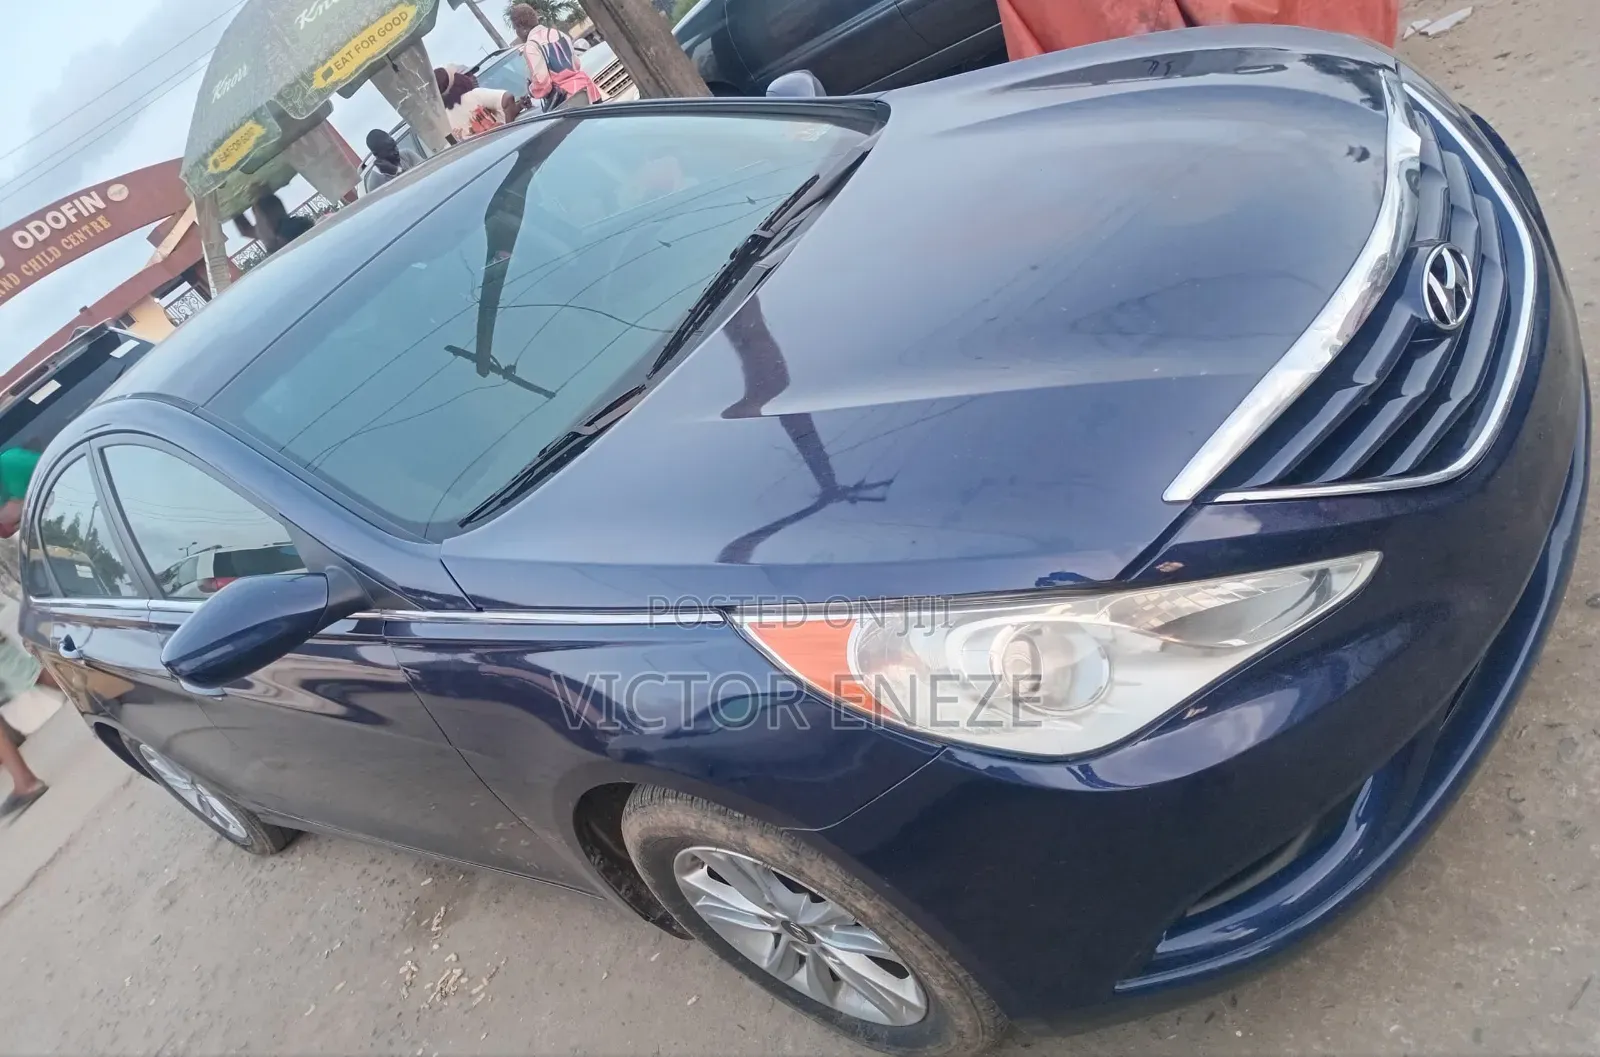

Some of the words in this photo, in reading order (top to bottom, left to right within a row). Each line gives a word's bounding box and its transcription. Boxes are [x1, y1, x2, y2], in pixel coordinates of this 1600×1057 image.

[294, 0, 340, 30] Kn
[333, 50, 355, 71] EAT
[354, 34, 377, 54] FOR
[377, 11, 408, 37] GOOD
[12, 191, 107, 249] ODOFIN
[20, 246, 61, 276] CHILD
[61, 214, 112, 250] CENTRE
